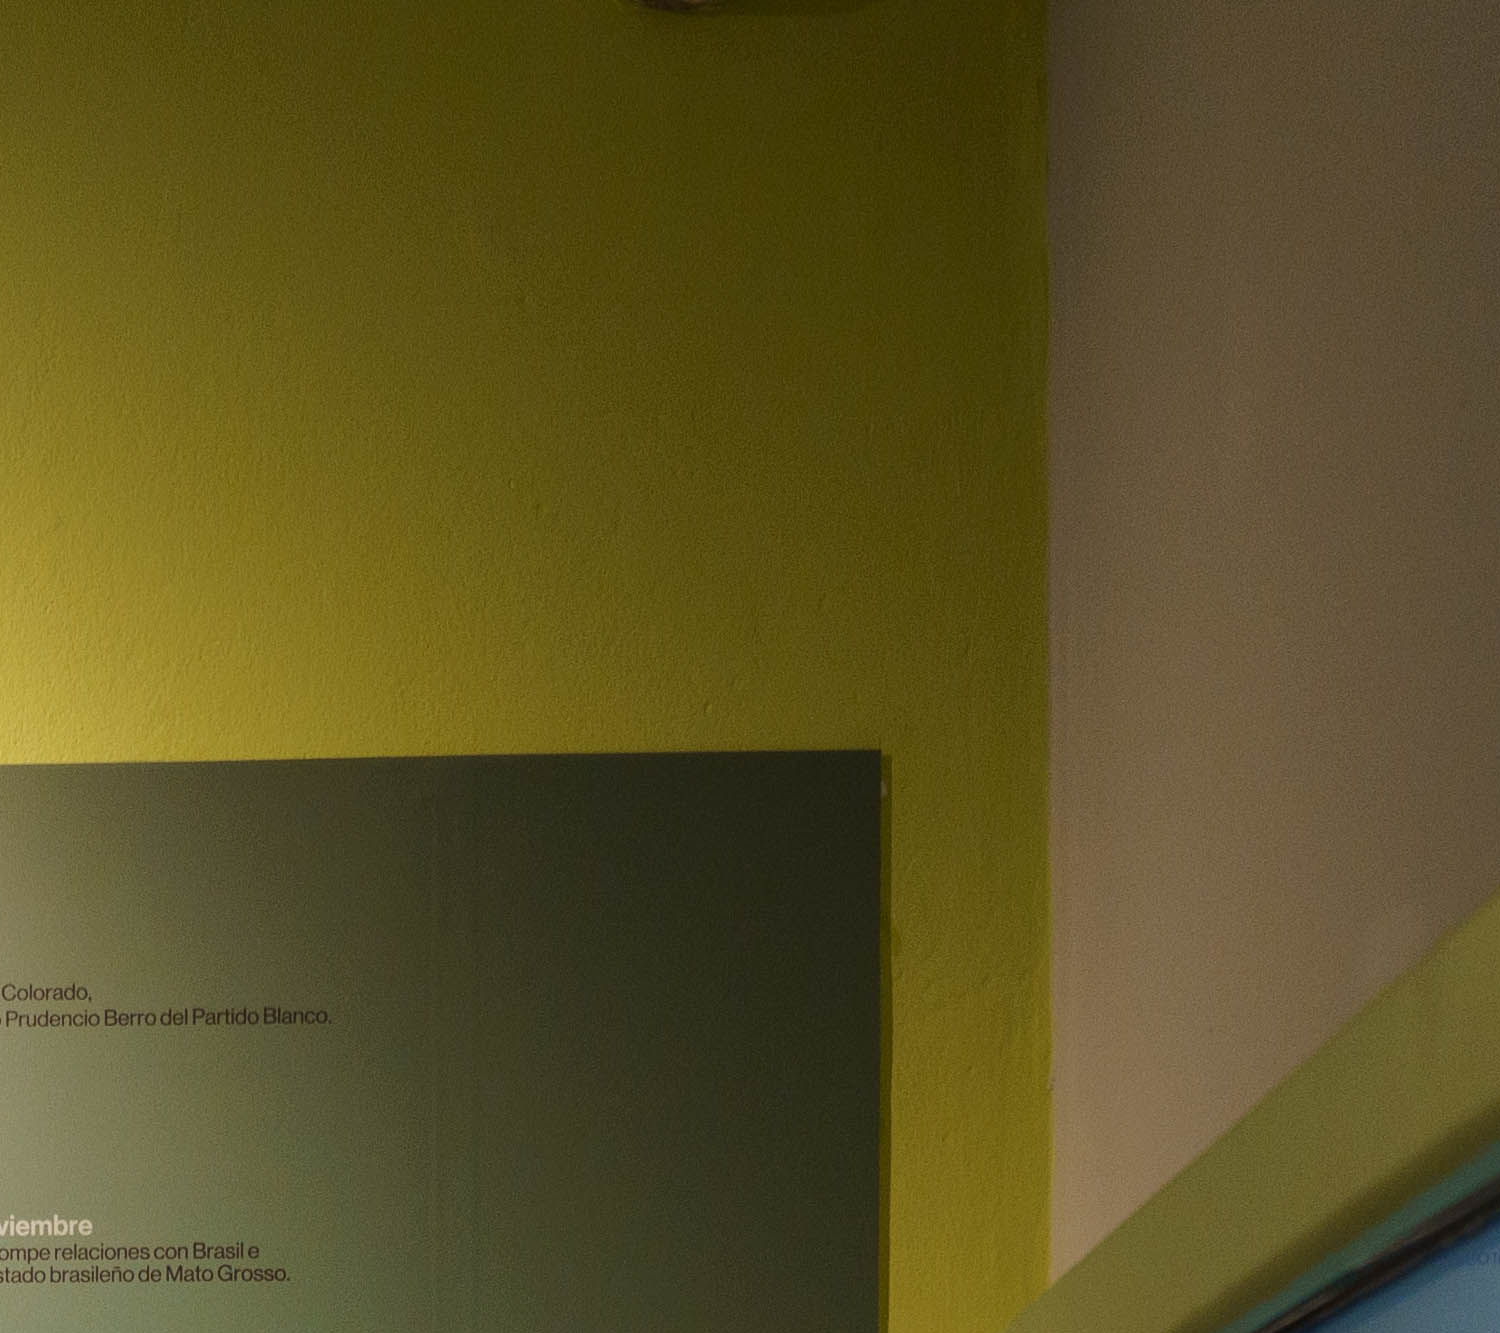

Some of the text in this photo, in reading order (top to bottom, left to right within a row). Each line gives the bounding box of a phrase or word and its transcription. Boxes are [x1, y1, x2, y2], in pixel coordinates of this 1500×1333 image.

[0, 982, 93, 1003] Colorado,
[54, 1242, 151, 1261] relaciones
[153, 1245, 189, 1260] con
[192, 1241, 245, 1260] Brasil
[247, 1245, 260, 1260] e
